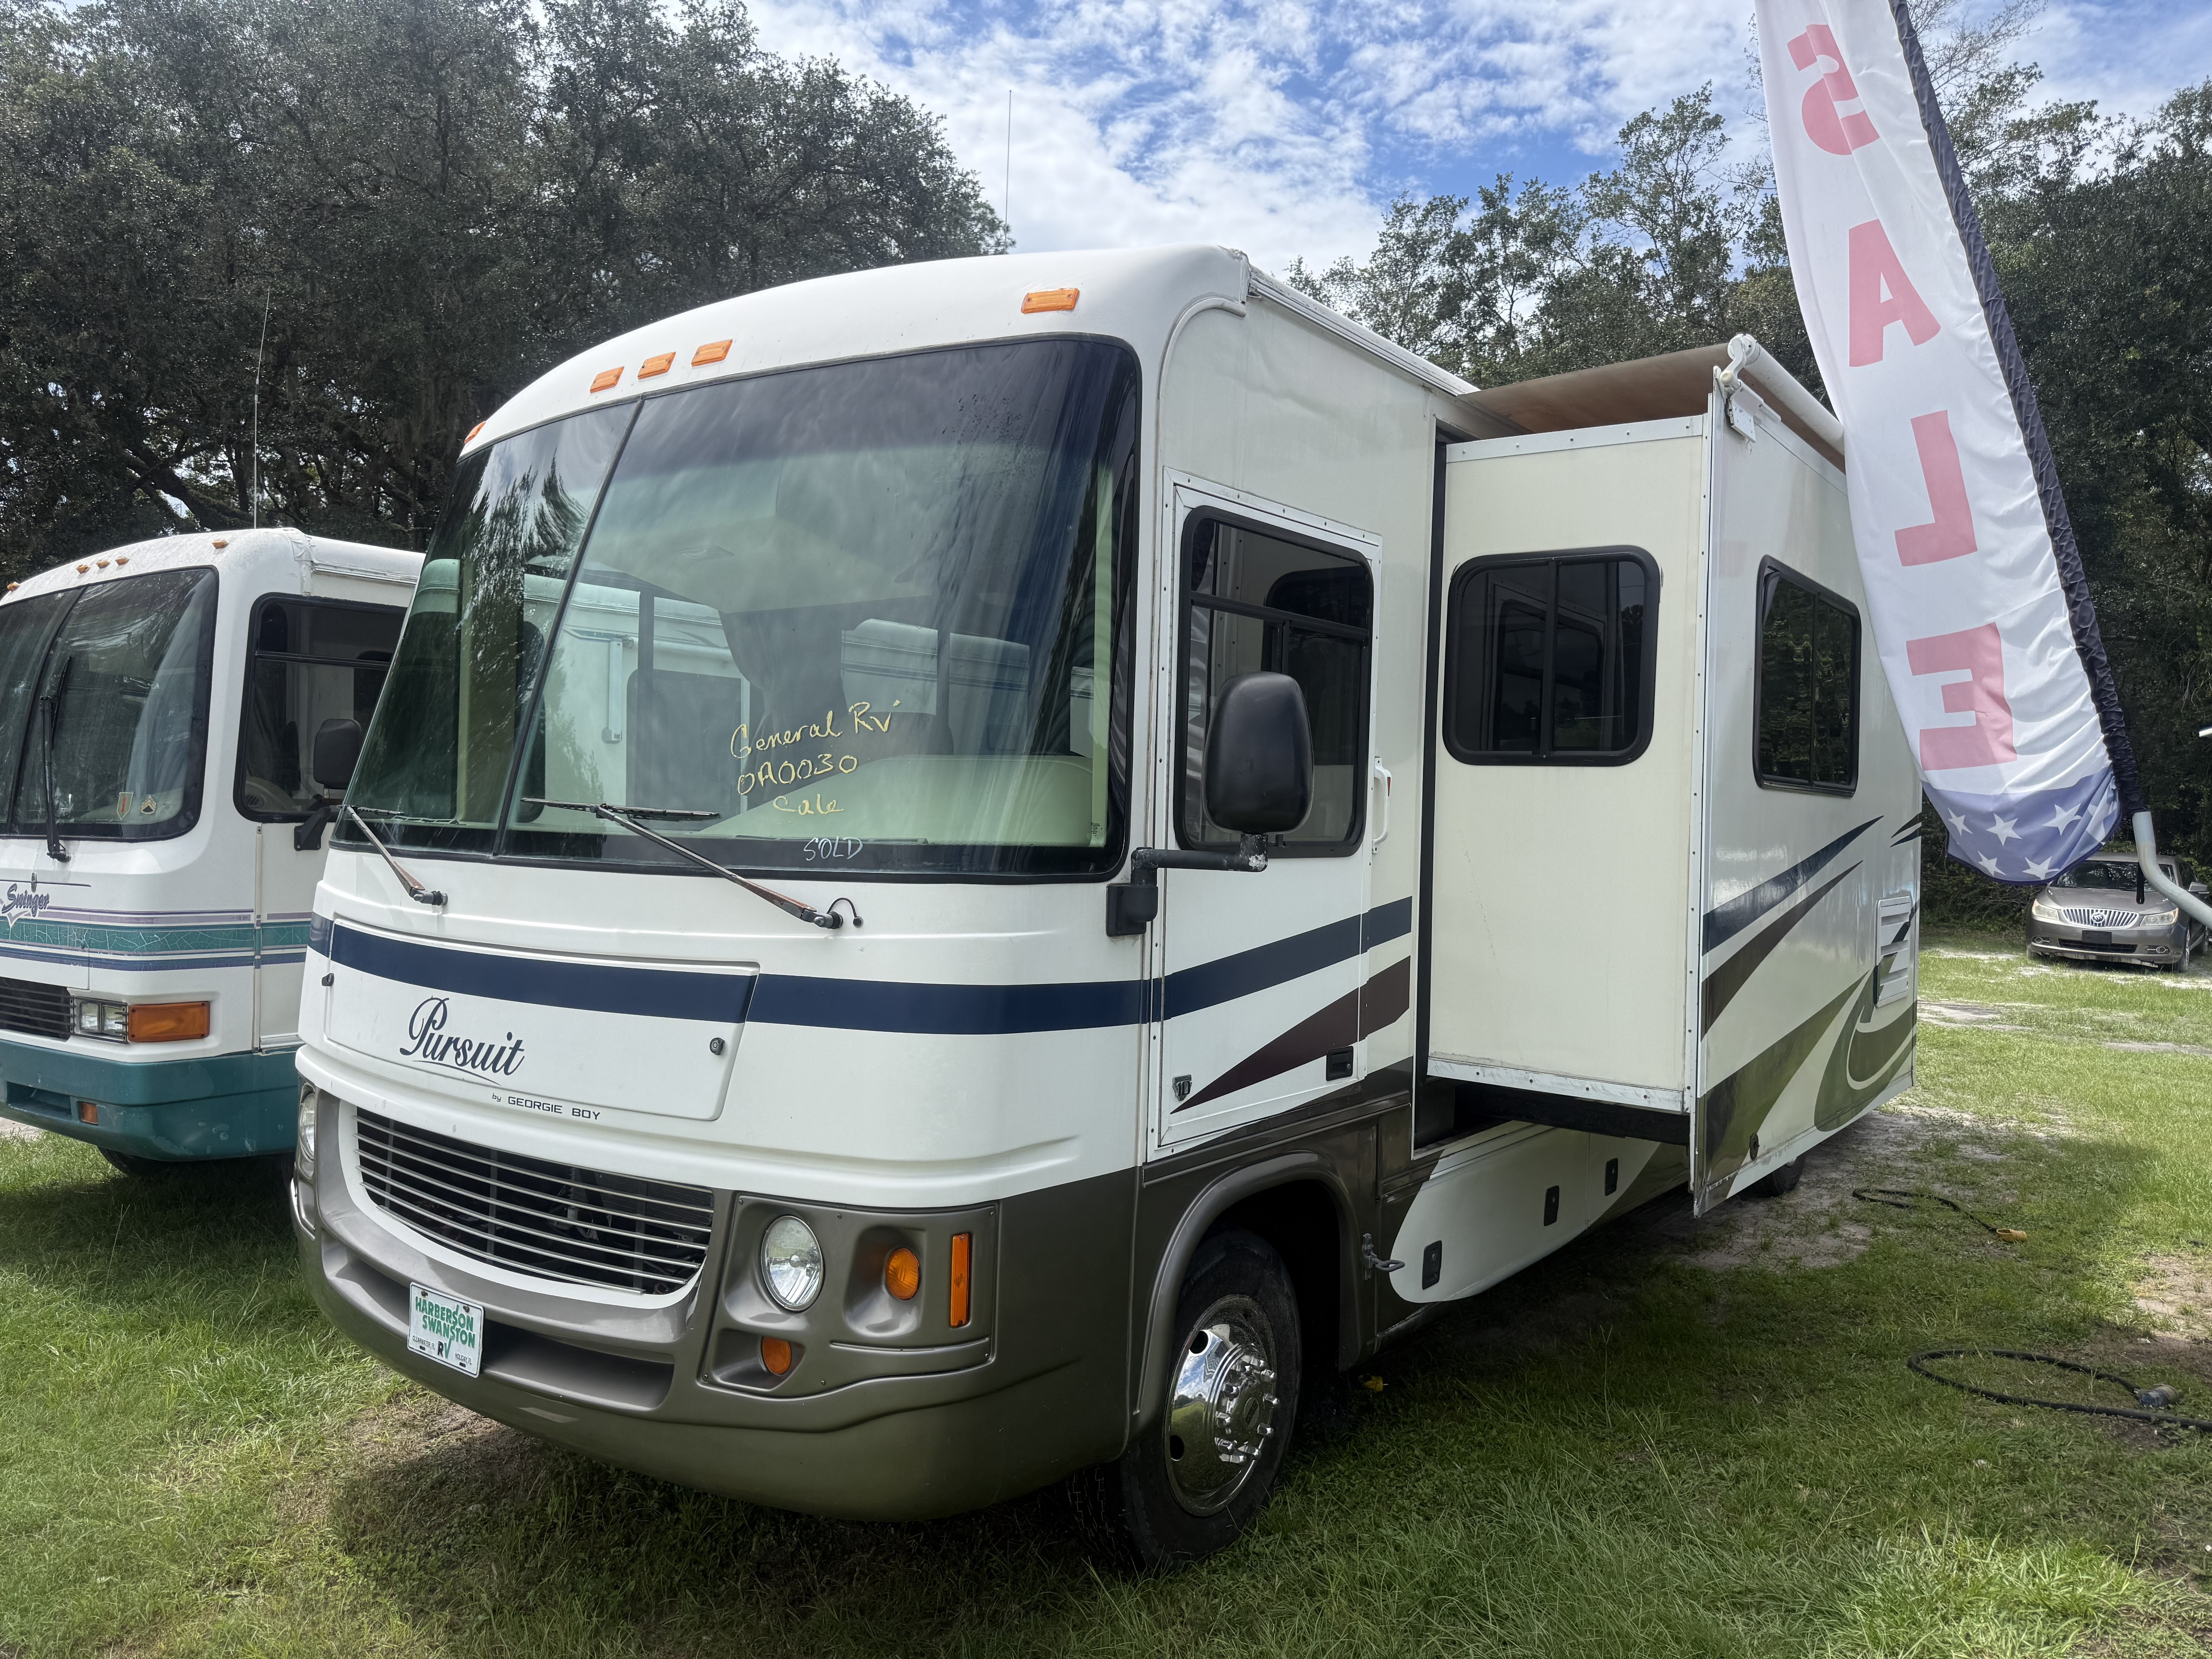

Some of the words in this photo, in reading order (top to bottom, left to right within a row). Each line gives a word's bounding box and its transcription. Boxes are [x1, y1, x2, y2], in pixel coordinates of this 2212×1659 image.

[730, 710, 842, 758] General
[803, 836, 864, 861] SOLD
[2, 883, 50, 917] Swinger
[399, 995, 525, 1075] Pursuit
[492, 1093, 502, 1102] by
[508, 1096, 563, 1114] GEORGIE
[572, 1108, 601, 1120] BOY
[416, 1297, 473, 1332] HARBERSON
[422, 1315, 475, 1348] SWANSTON
